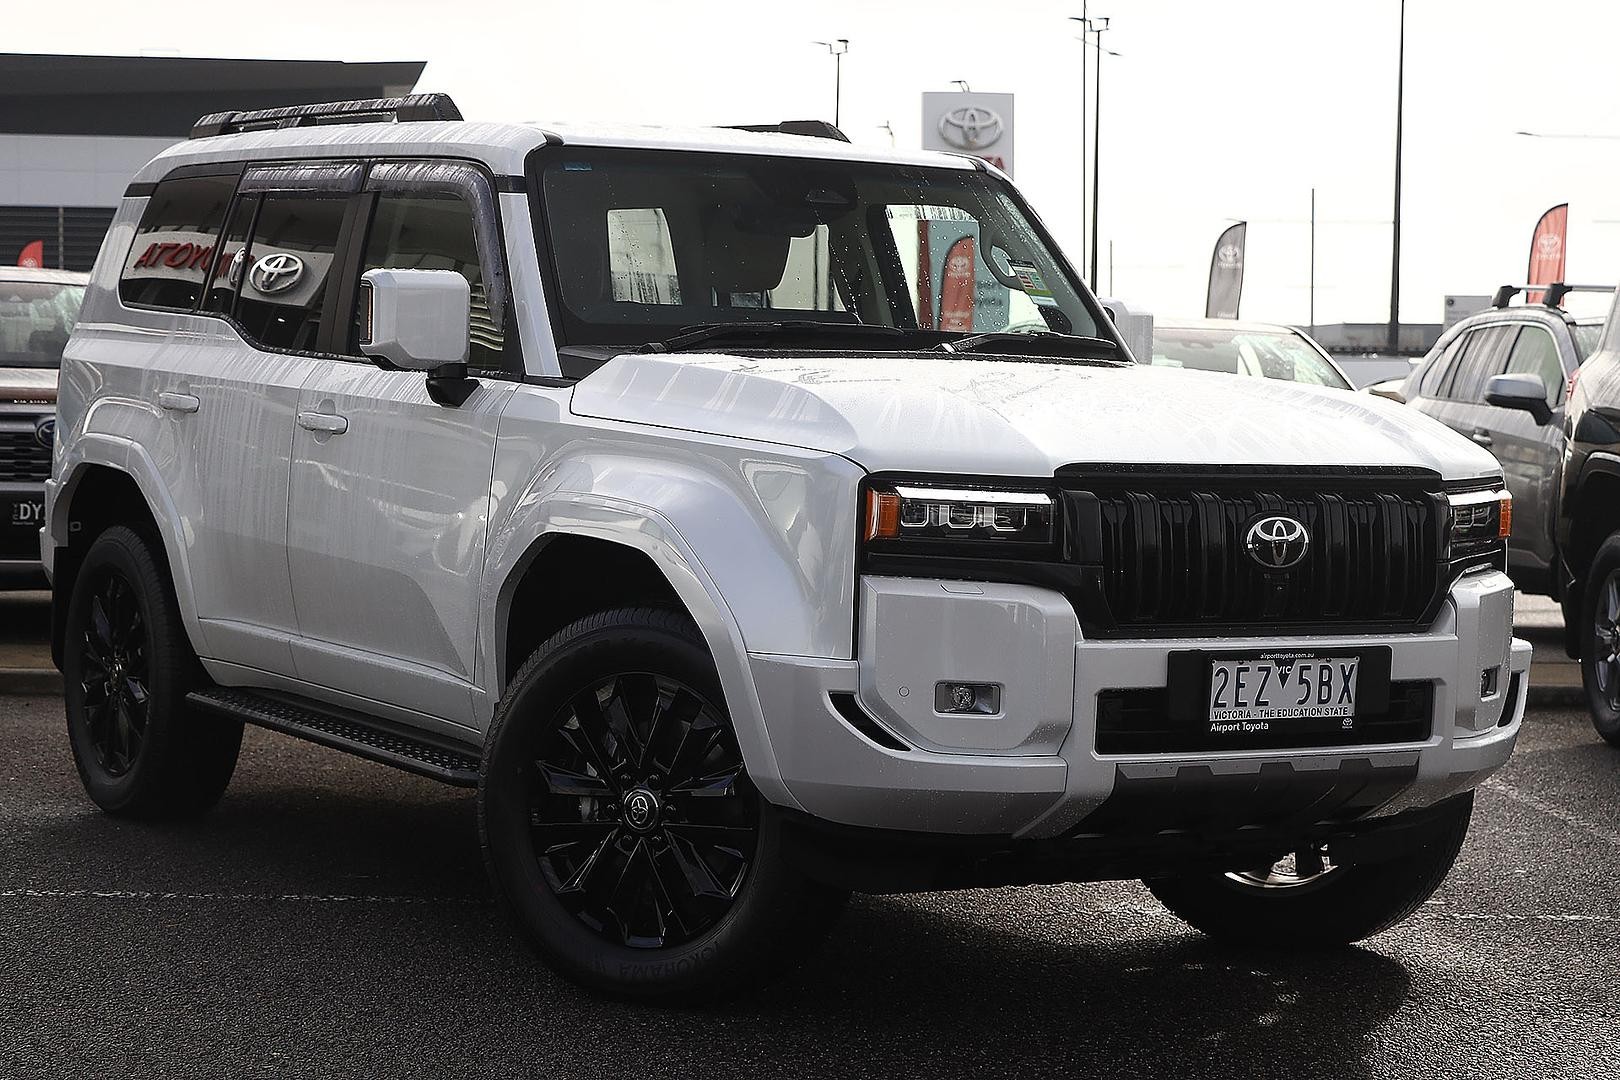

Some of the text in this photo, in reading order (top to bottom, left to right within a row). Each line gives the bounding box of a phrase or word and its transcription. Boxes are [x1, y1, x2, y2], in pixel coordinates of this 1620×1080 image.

[1260, 652, 1315, 660] airporttoyota.com.au
[1276, 666, 1291, 674] VIC
[1213, 664, 1356, 708] 2EZ 5BX
[1213, 710, 1251, 720] VICTORIA
[1260, 709, 1274, 719] THE
[1277, 708, 1322, 718] EDUCATION
[1324, 706, 1348, 717] STATE
[1211, 722, 1269, 733] Airport Toyota
